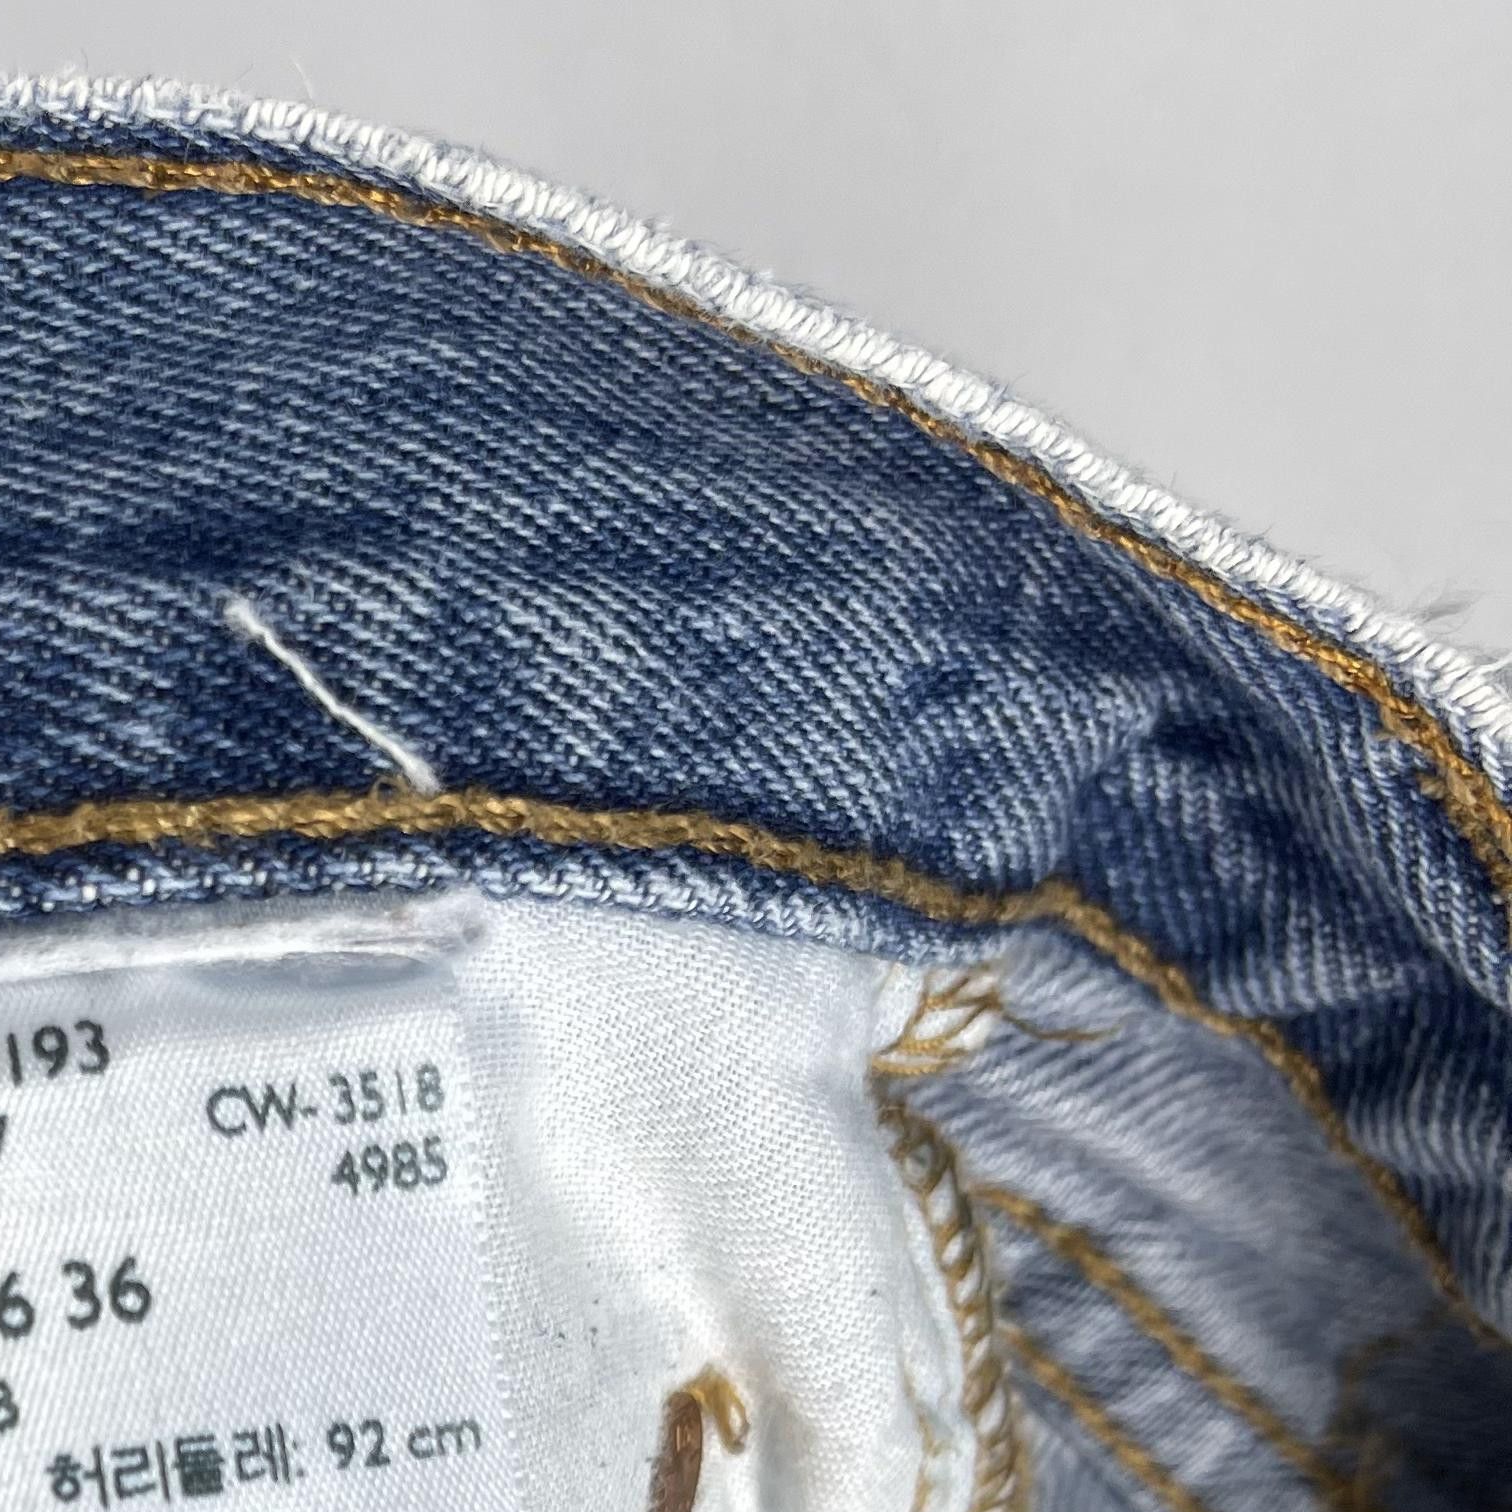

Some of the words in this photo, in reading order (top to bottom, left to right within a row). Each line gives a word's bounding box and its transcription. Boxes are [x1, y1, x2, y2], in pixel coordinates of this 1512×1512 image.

[205, 1081, 318, 1139] CW-
[327, 1062, 445, 1125] 3518
[330, 1134, 448, 1195] 4985
[61, 1256, 152, 1330] 36
[326, 1417, 392, 1471] 92
[407, 1416, 484, 1462] cm
